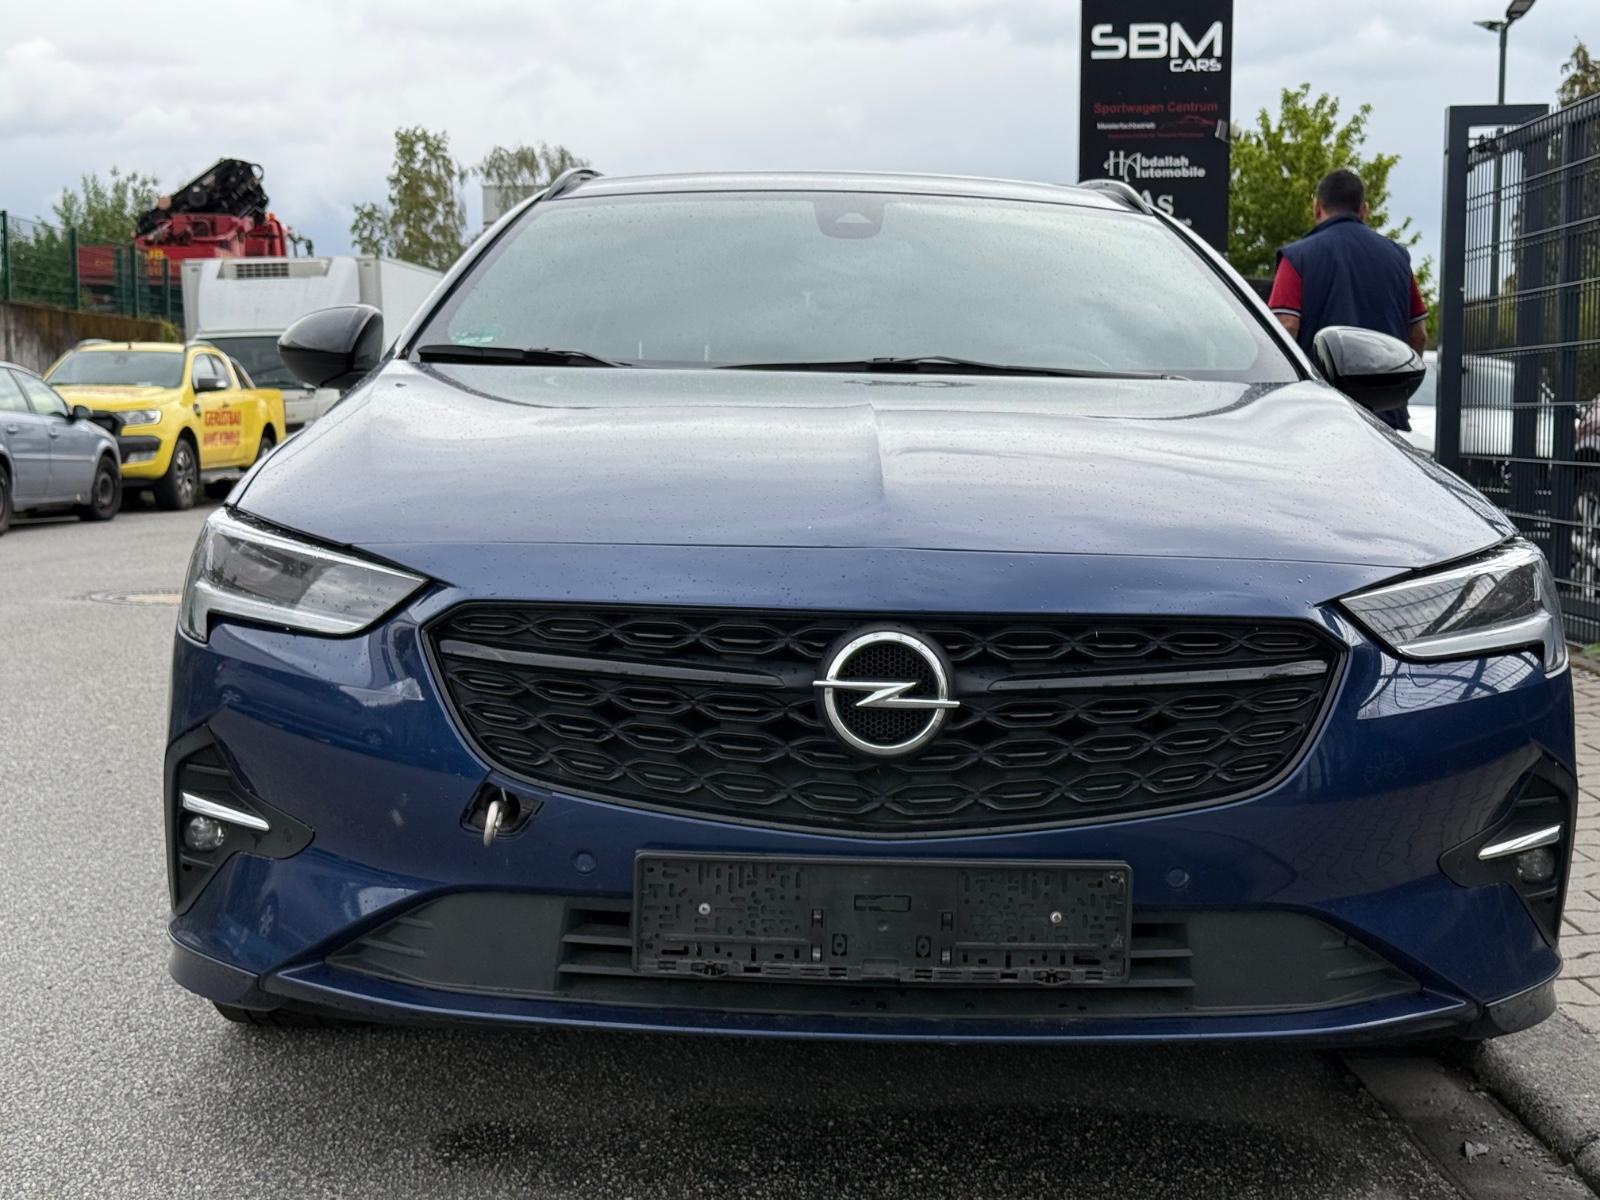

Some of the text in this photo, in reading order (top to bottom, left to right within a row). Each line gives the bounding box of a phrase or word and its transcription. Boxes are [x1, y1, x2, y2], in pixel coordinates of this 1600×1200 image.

[1091, 21, 1223, 60] SBM
[1169, 58, 1222, 73] CARS
[1093, 102, 1217, 116] Sportwagen Centrum
